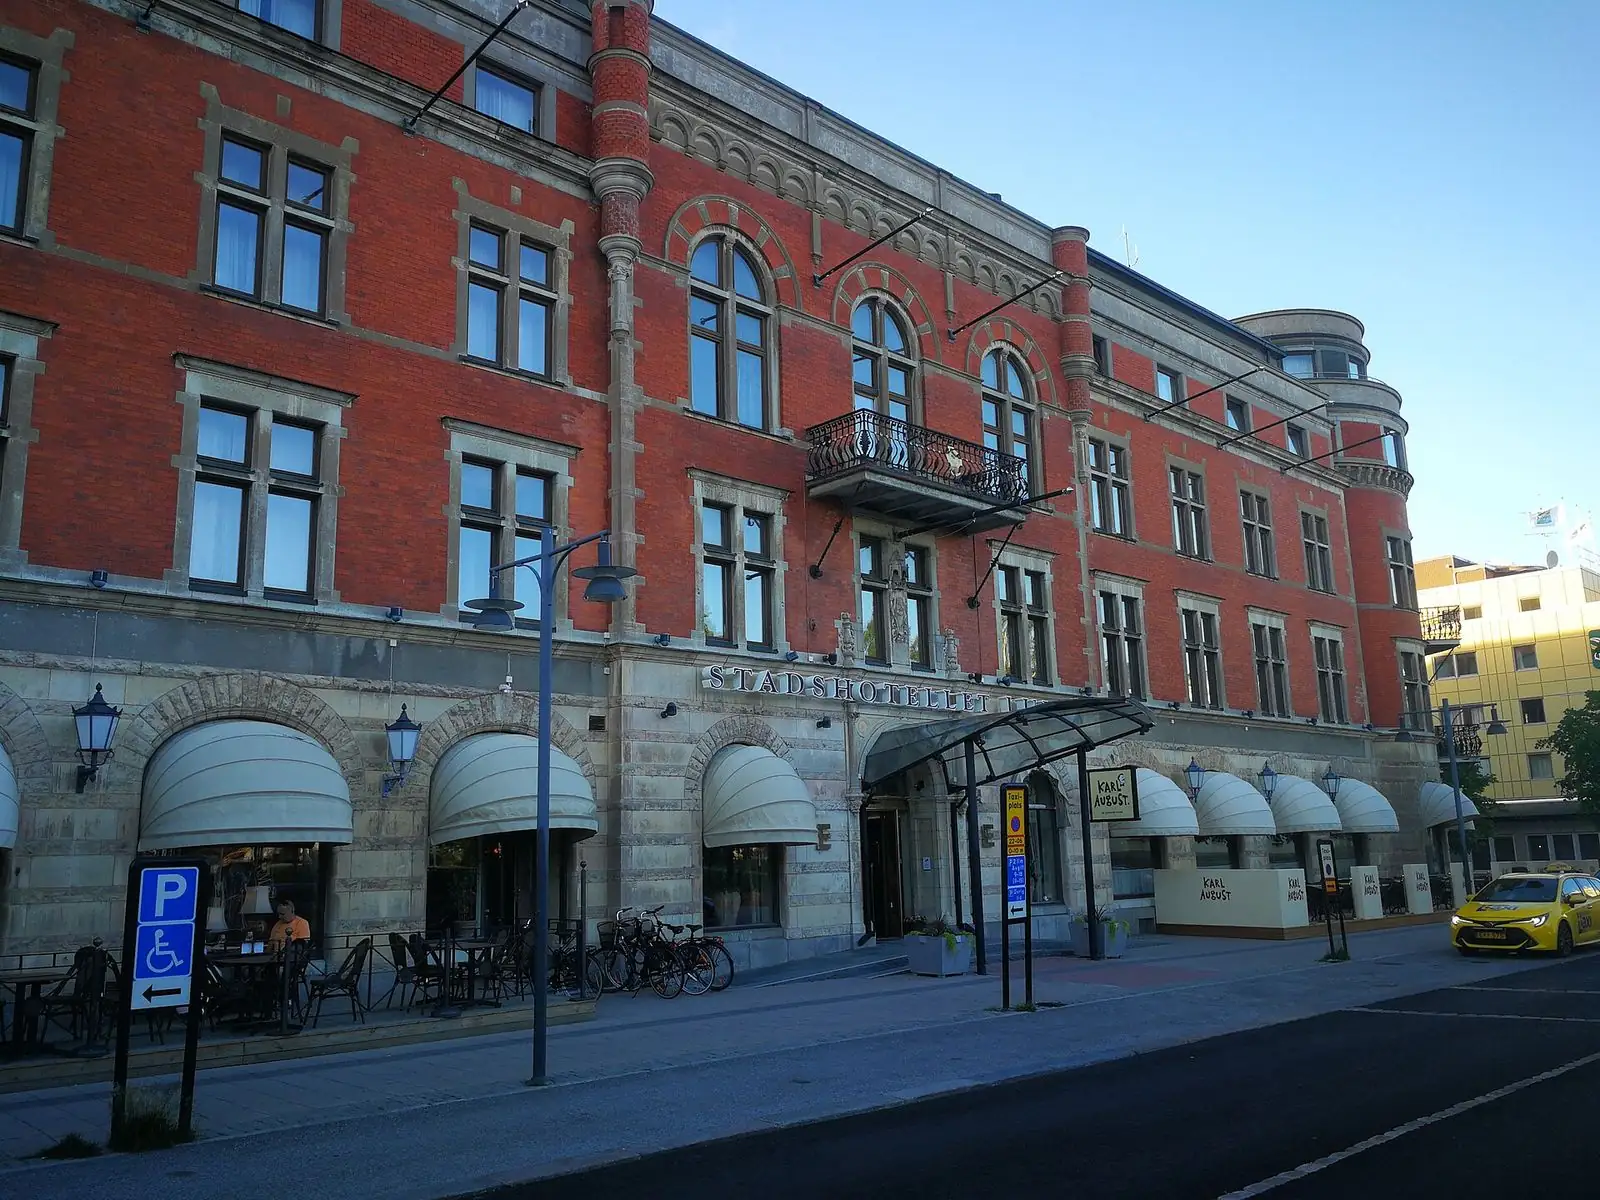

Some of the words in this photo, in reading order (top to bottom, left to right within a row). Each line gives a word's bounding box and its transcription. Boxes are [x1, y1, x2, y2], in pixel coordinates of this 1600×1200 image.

[703, 666, 990, 713] STADSHOTELLET
[1097, 780, 1121, 793] KARL
[1203, 877, 1225, 888] KARL
[1287, 877, 1301, 889] KARL
[154, 873, 187, 917] P
[1200, 889, 1231, 901] AUGUST
[1287, 890, 1304, 902] AUGUST
